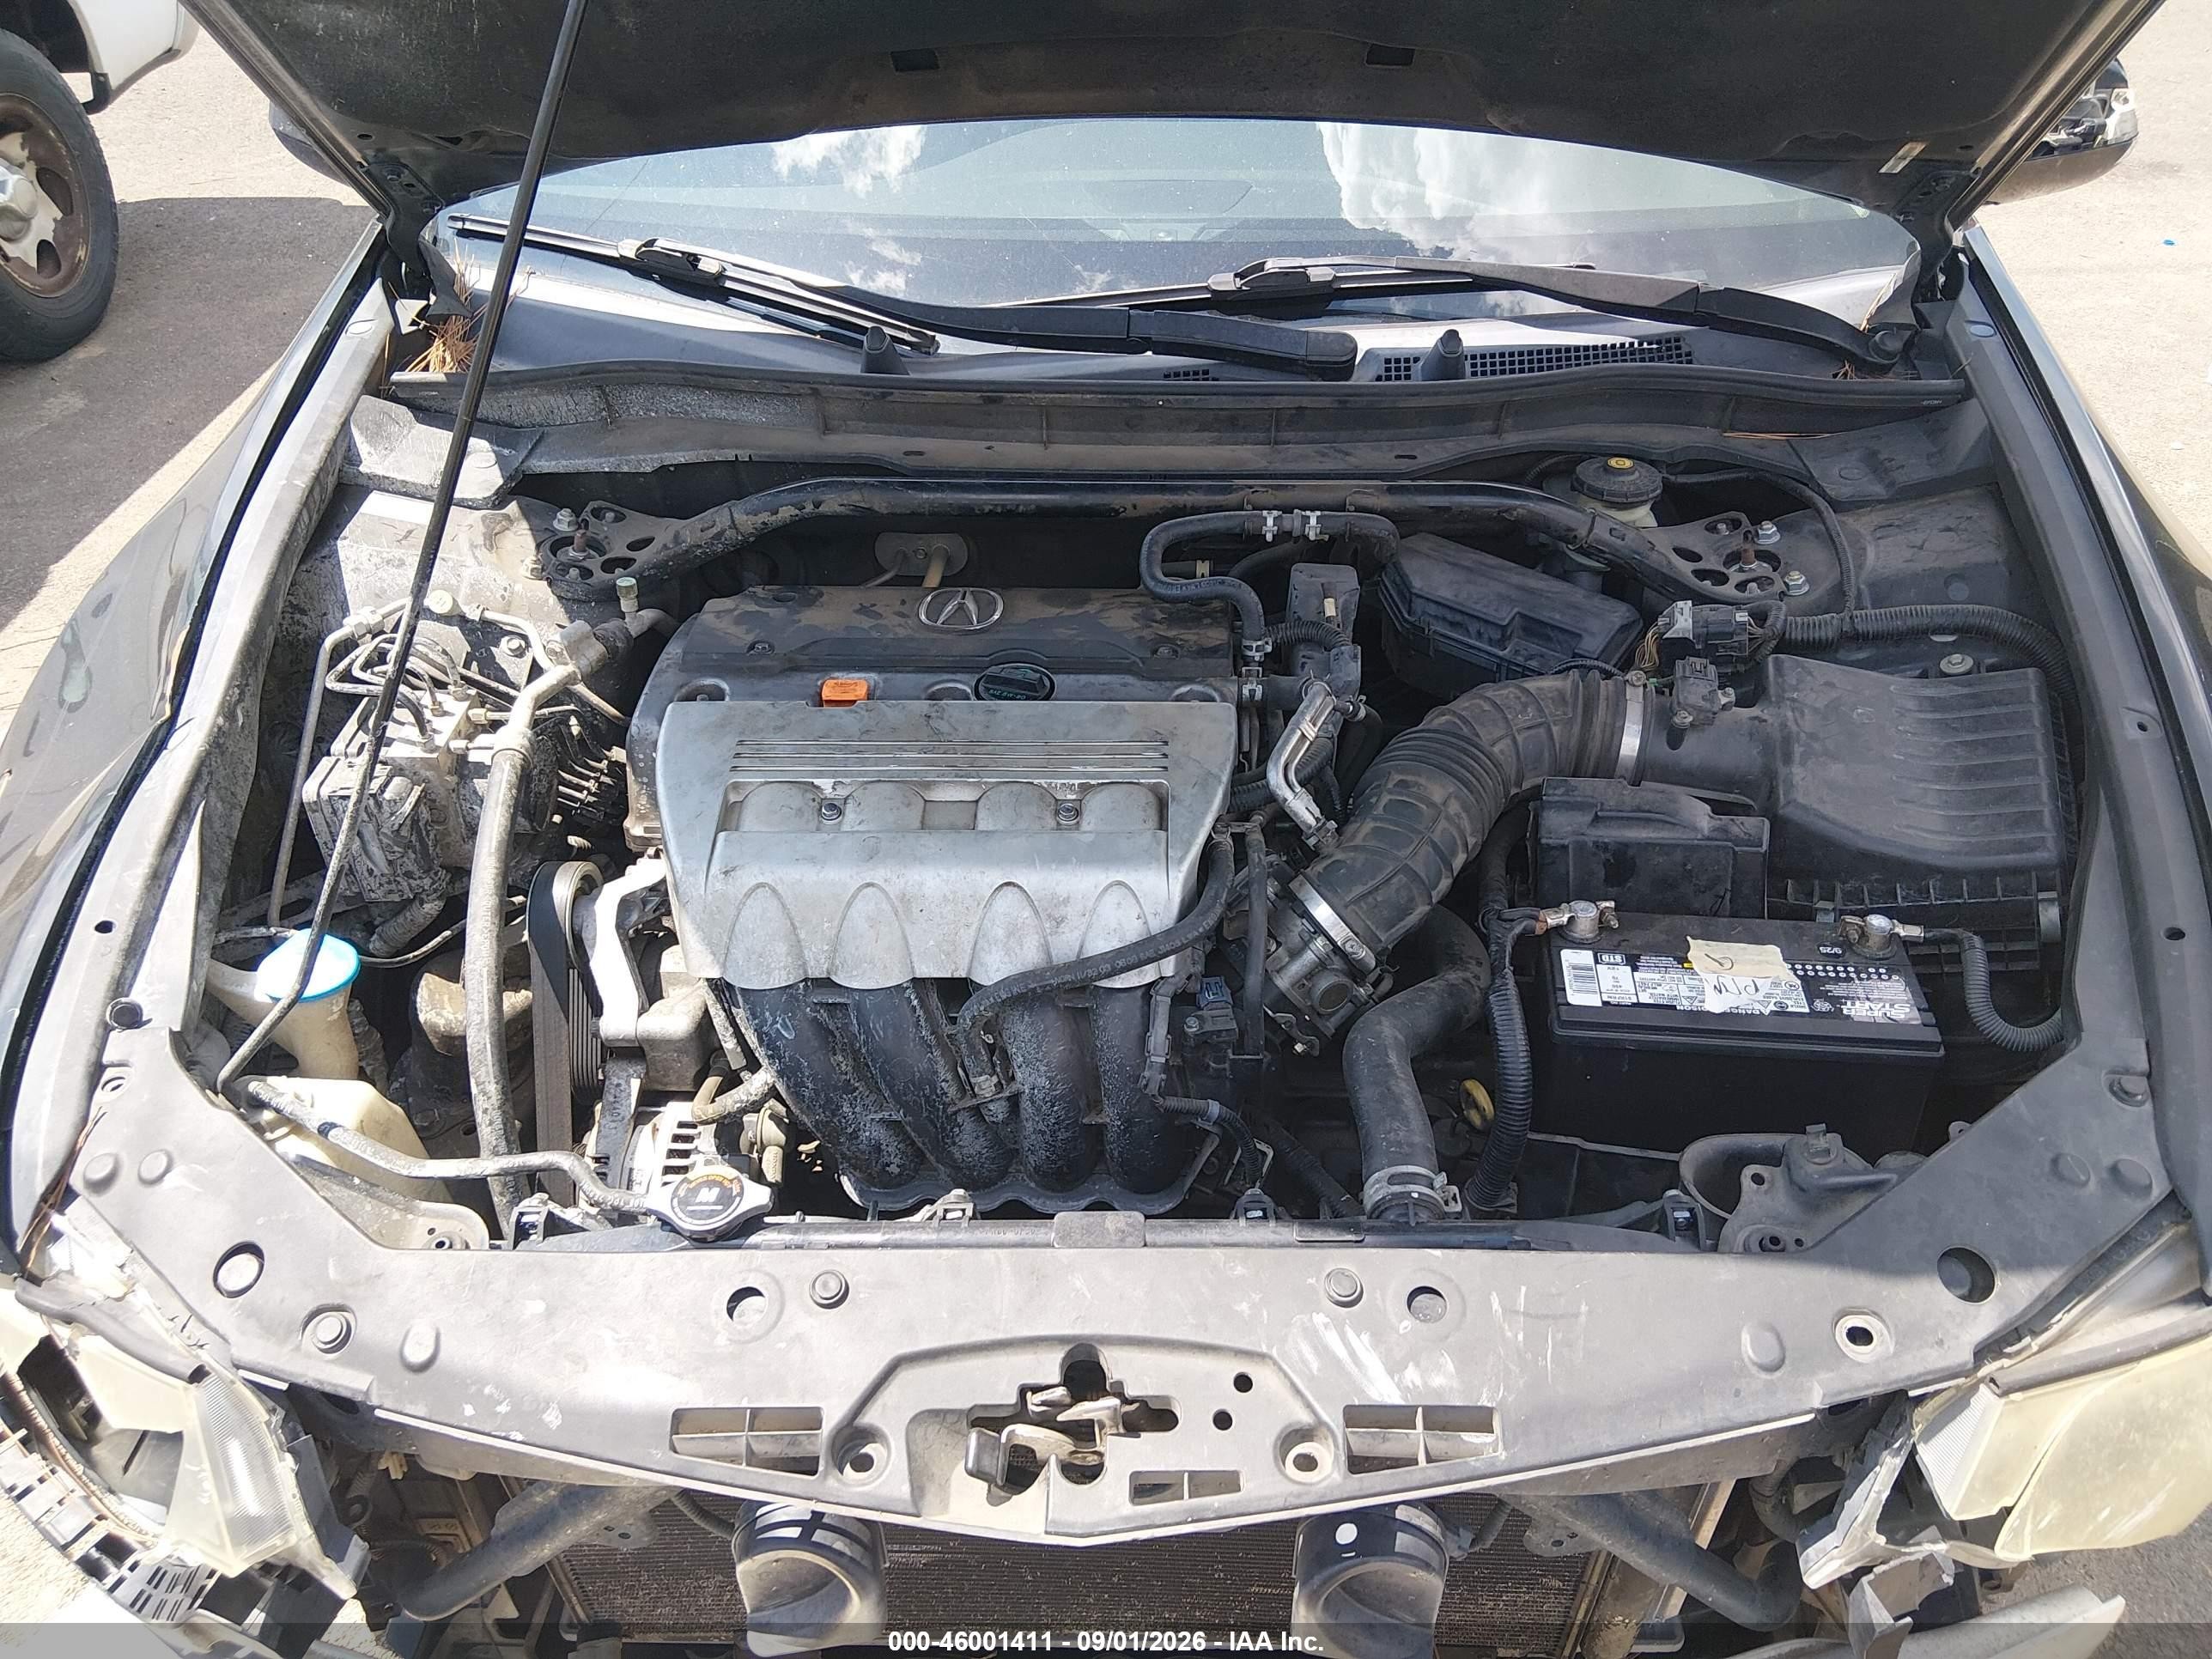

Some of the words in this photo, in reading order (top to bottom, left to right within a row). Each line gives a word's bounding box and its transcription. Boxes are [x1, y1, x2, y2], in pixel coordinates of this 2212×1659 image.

[1602, 954, 1622, 963] STD
[1841, 1000, 1910, 1012] START
[1843, 1007, 1905, 1019] SUPER
